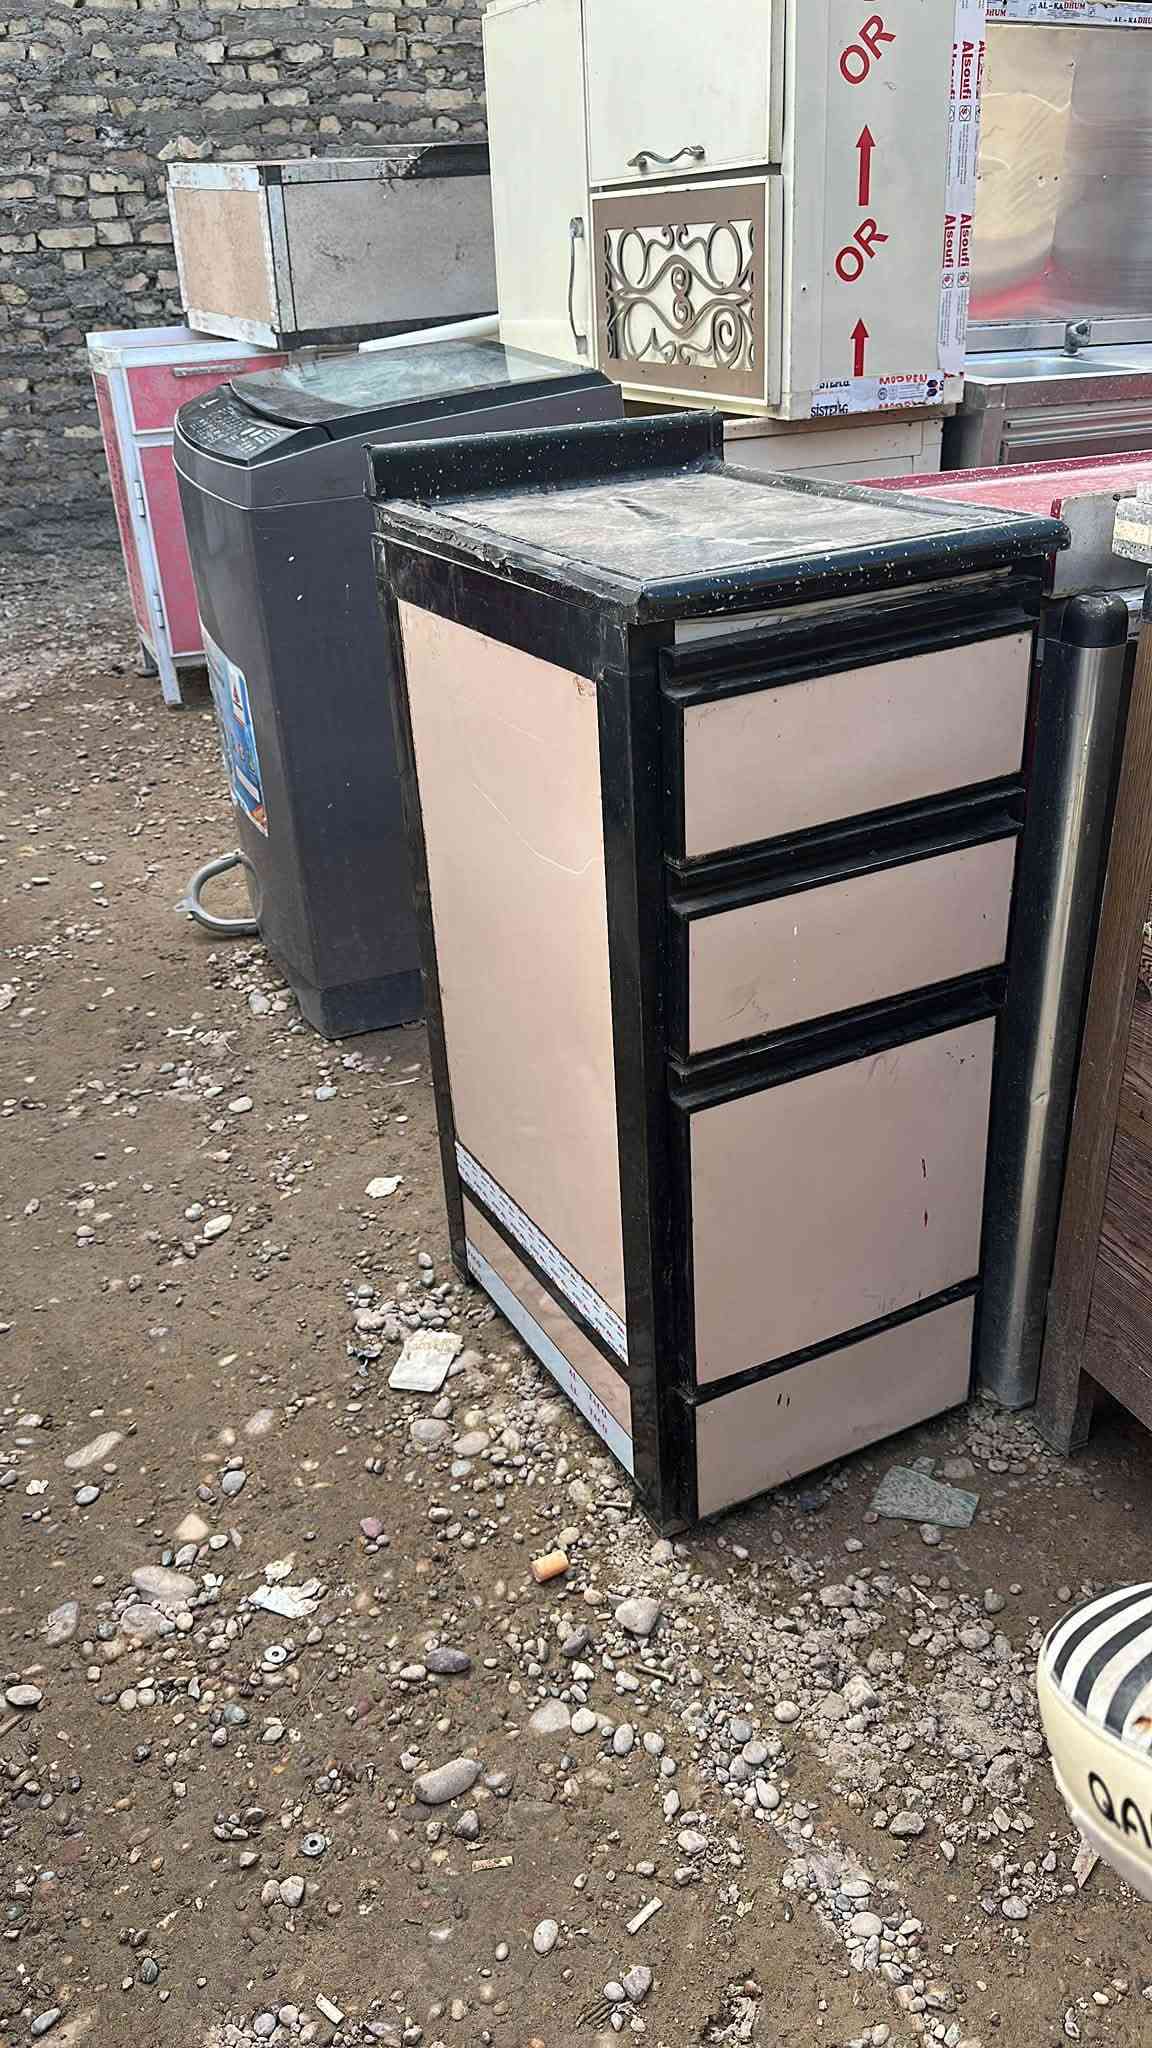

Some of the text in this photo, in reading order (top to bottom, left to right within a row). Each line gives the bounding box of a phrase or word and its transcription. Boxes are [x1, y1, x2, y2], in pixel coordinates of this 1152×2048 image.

[839, 15, 896, 84] OR
[960, 41, 974, 100] Alsoufi
[835, 218, 889, 282] OR
[943, 214, 956, 268] Alsoufi
[958, 213, 972, 267] Alsoufi
[1088, 1771, 1152, 1848] QA
